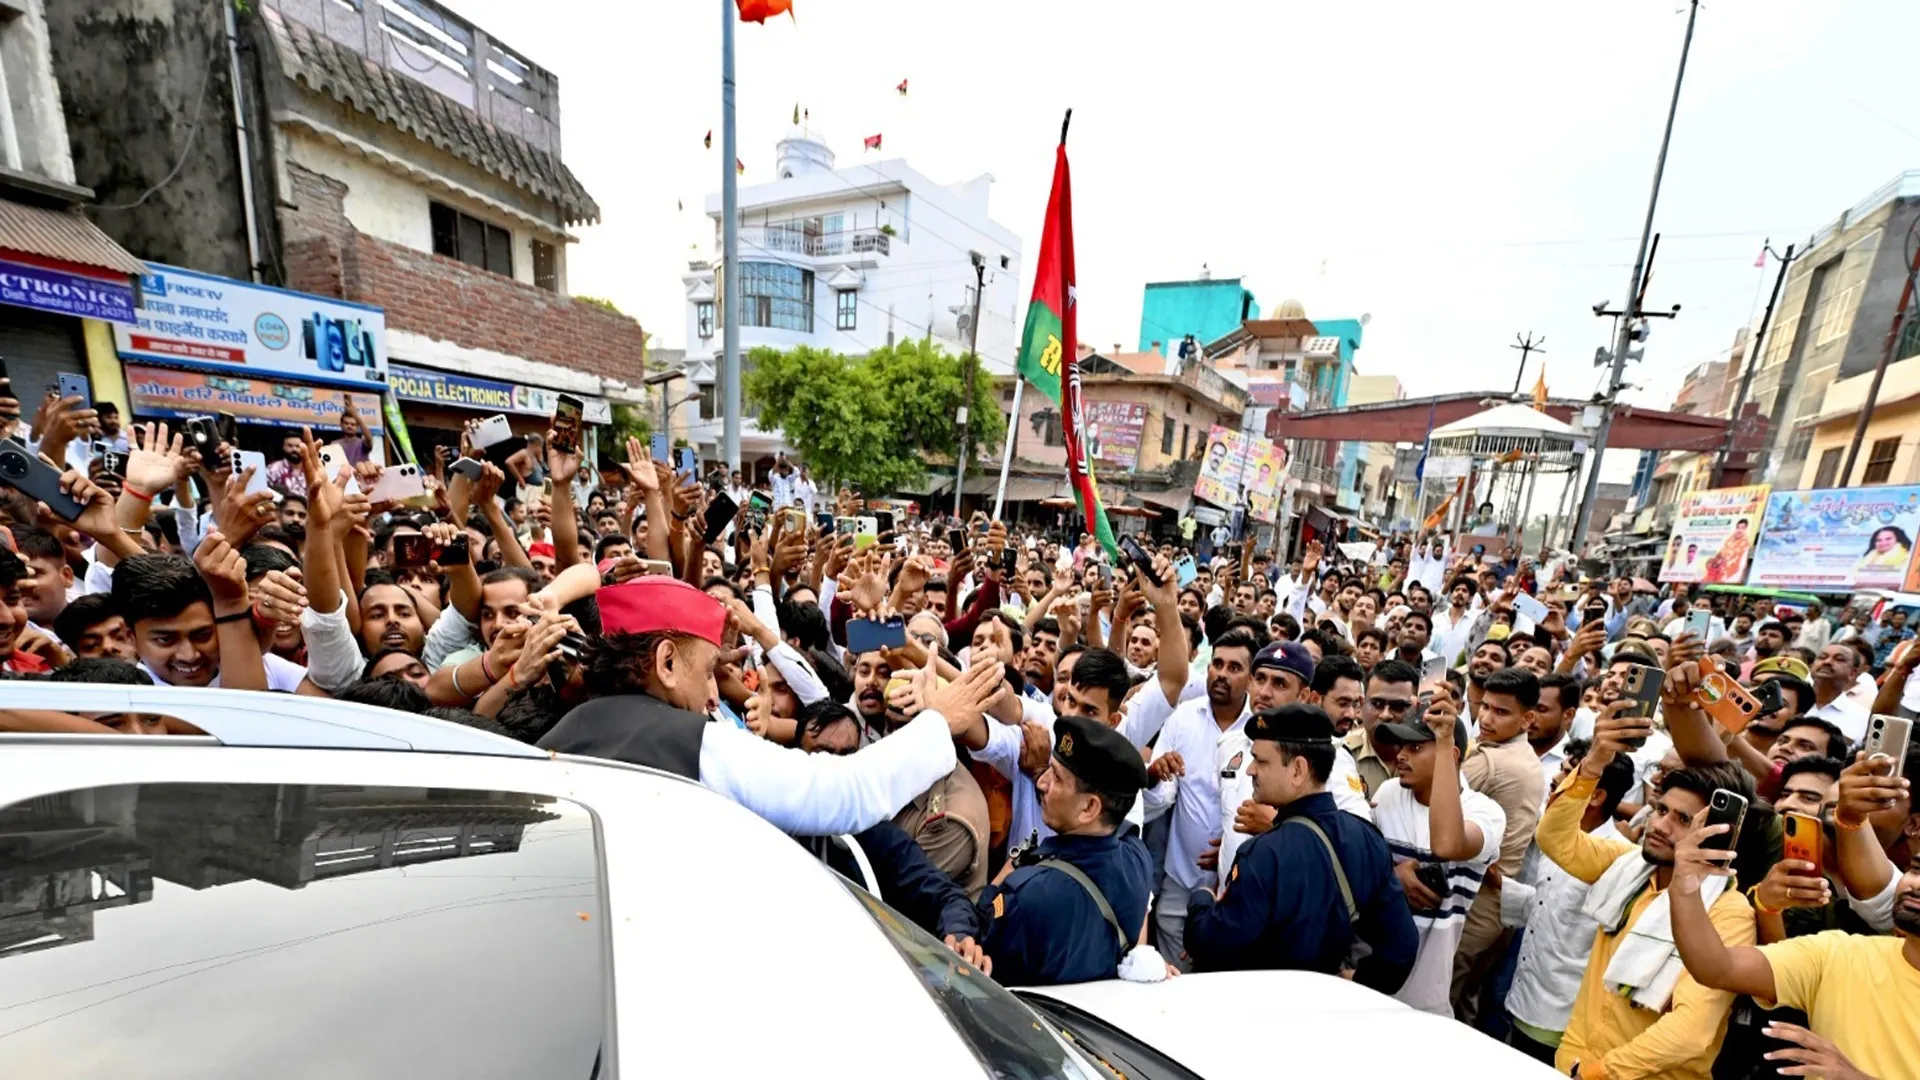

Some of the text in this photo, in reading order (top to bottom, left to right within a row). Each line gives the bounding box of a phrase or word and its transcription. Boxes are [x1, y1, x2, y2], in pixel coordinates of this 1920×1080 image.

[30, 291, 72, 309] Sambhal
[167, 283, 223, 301] FINSERV
[178, 304, 228, 325] मनपसंद
[183, 385, 213, 401] हरि
[389, 375, 433, 399] POOJA
[434, 381, 511, 408] ELECTRONICS
